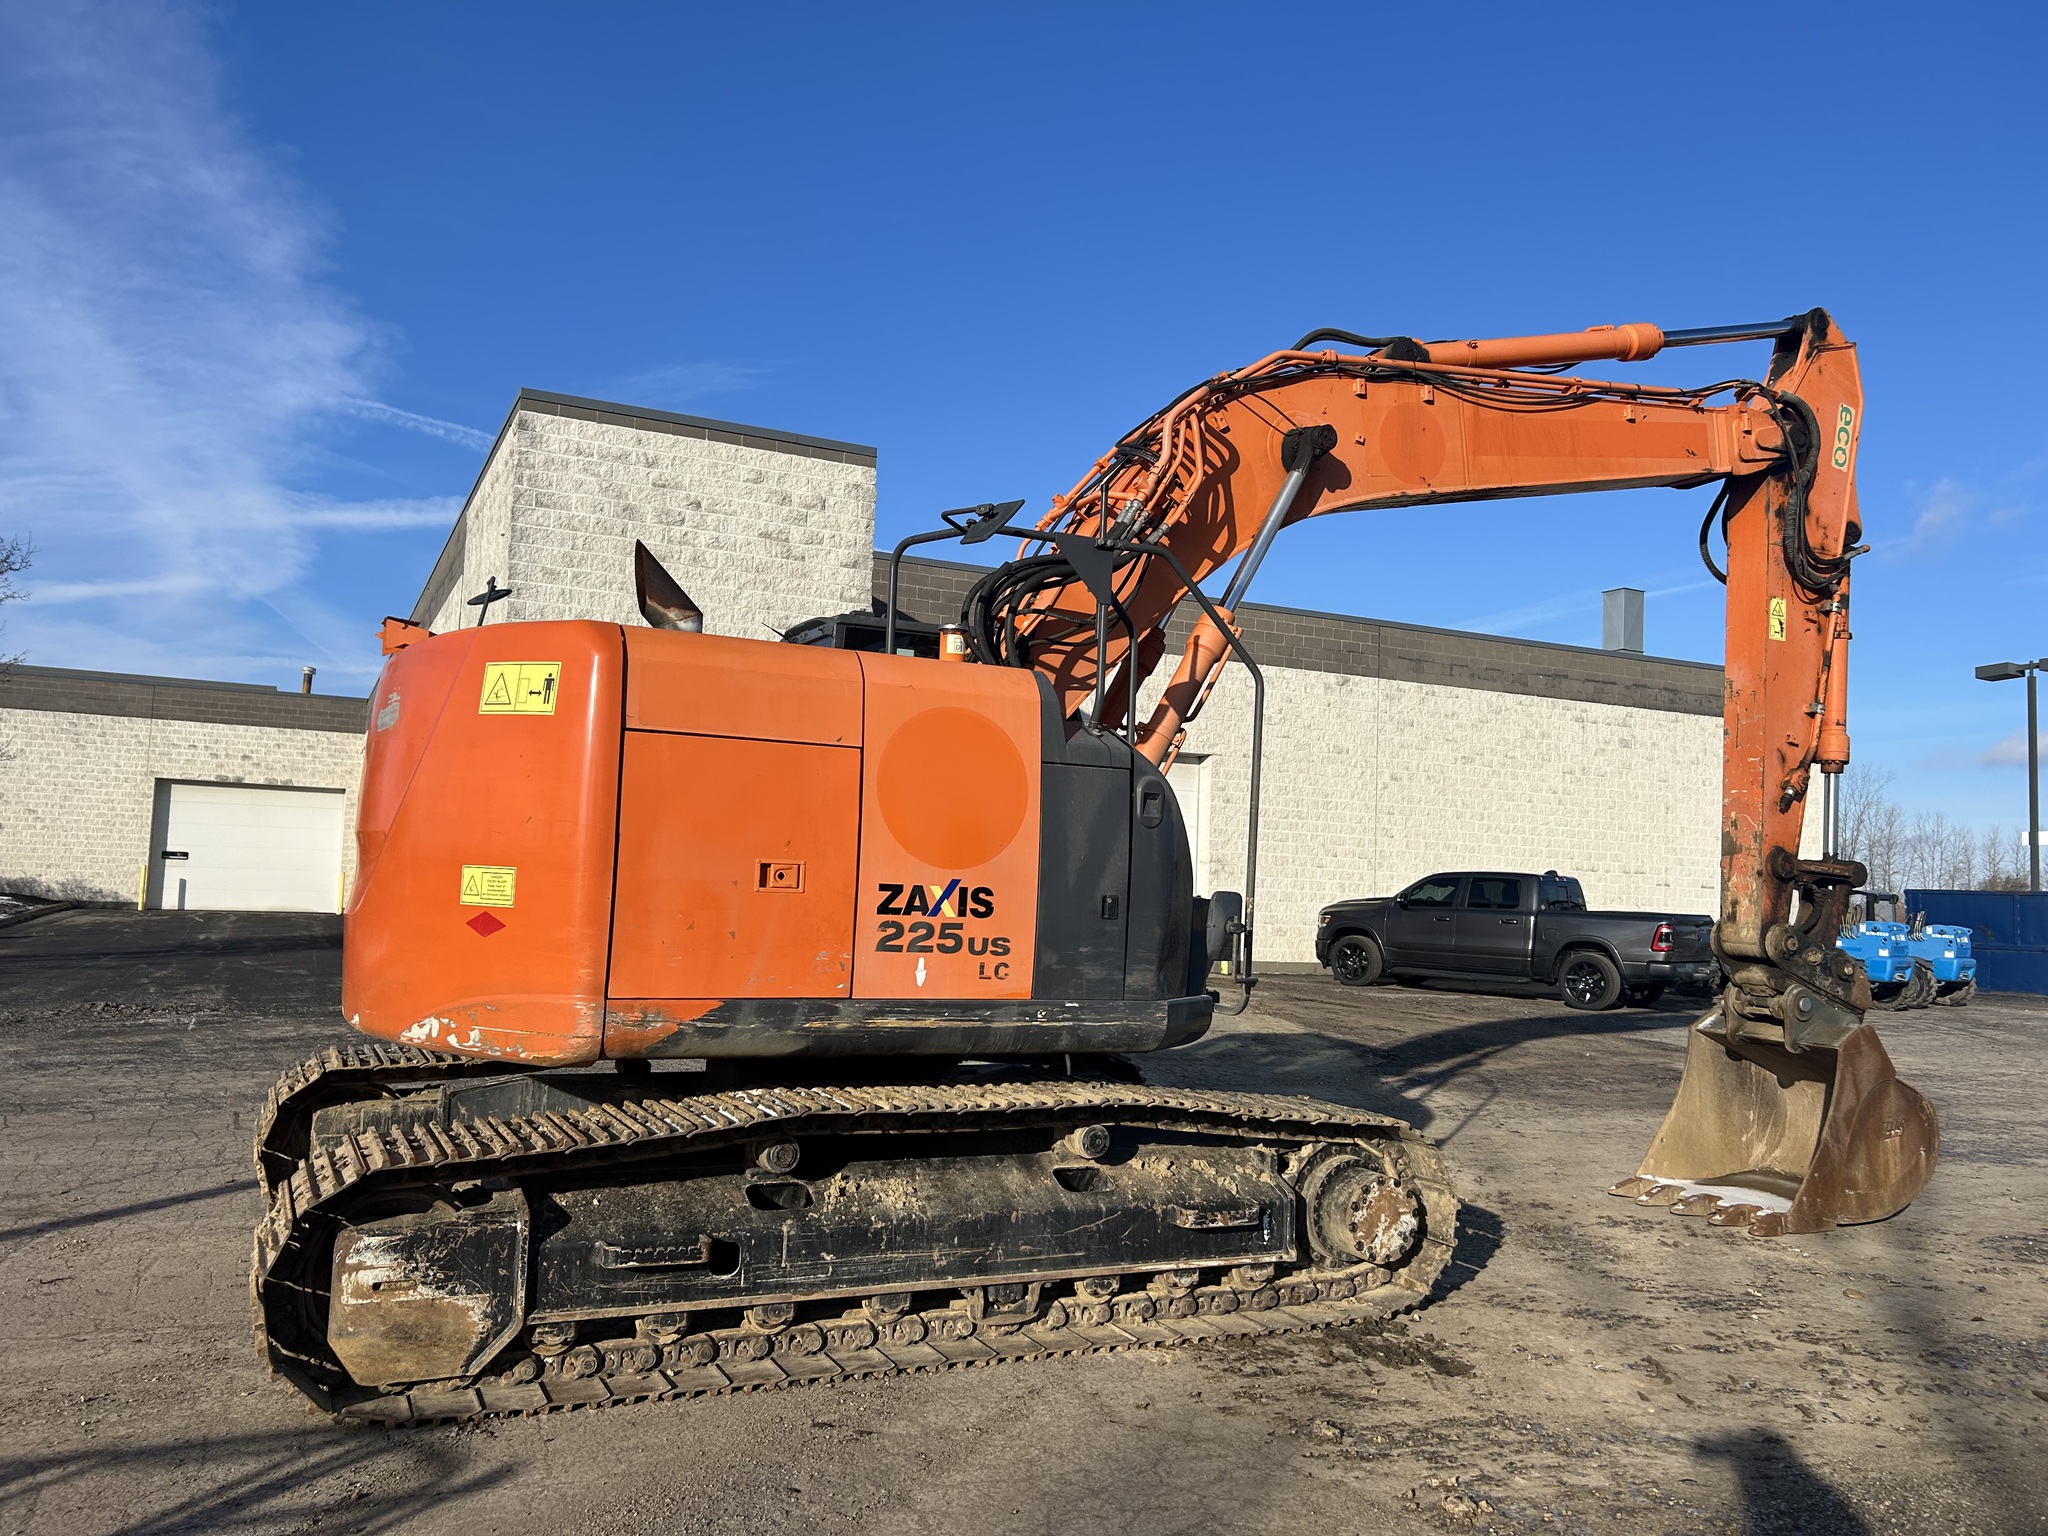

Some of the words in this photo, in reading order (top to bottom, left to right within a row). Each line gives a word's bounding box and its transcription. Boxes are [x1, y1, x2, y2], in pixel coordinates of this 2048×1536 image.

[1834, 406, 1853, 468] eco
[876, 878, 994, 919] ZAXIS
[978, 962, 1010, 981] LC
